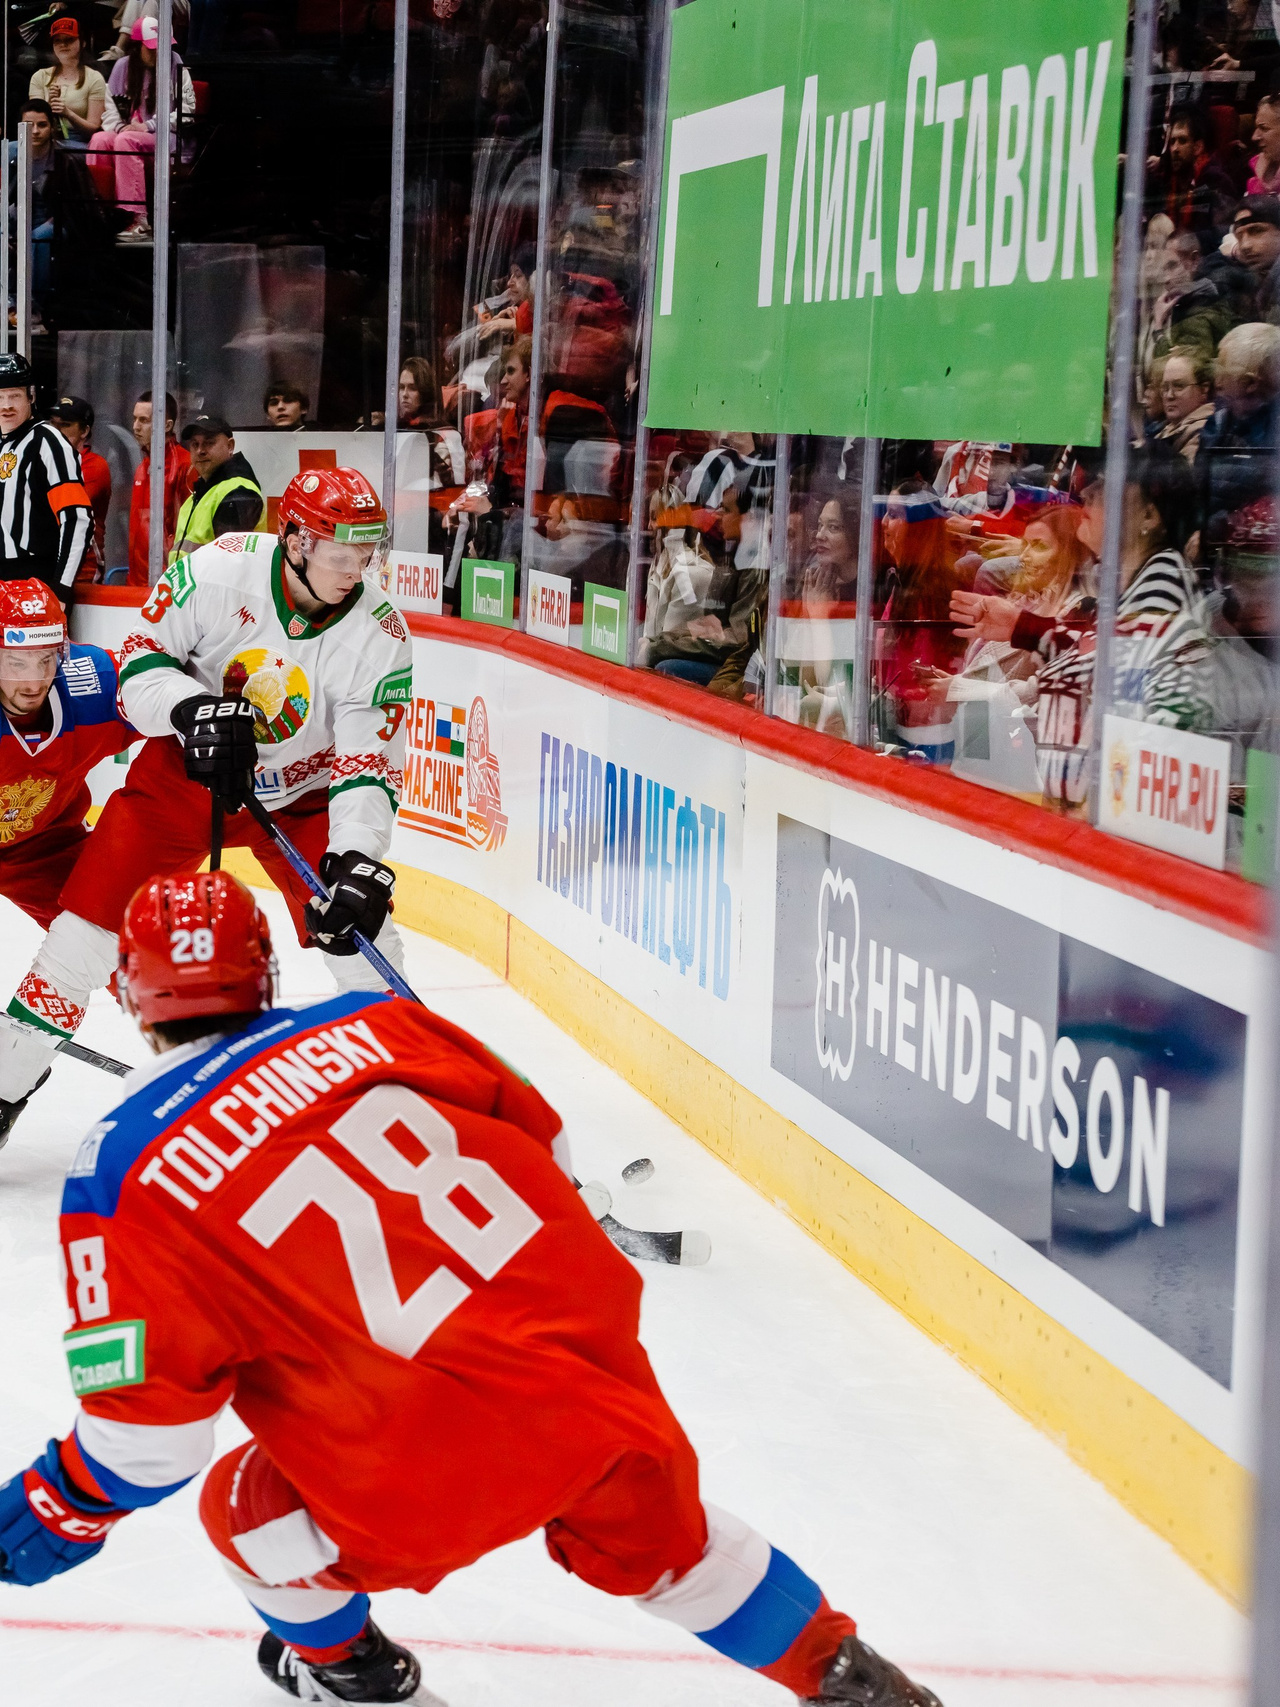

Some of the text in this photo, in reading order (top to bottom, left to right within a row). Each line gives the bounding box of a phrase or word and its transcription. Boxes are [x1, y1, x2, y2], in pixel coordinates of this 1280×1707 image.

[288, 508, 306, 524] CCM
[352, 493, 376, 508] 33
[396, 563, 439, 600] FHR.RU
[20, 600, 47, 615] 92
[541, 586, 568, 629] FHR.RU
[28, 630, 63, 640] НОРНИКЕЛЬ
[405, 697, 437, 752] RED
[401, 752, 465, 820] MACHINE
[1136, 749, 1220, 835] FHR.RU
[537, 731, 732, 1002] ГАЗПРОМНЕФТЬ
[170, 928, 215, 962] 28
[866, 938, 1171, 1228] HENDERSON
[137, 1018, 396, 1212] TOLCHINSKY
[237, 1083, 545, 1360] 28
